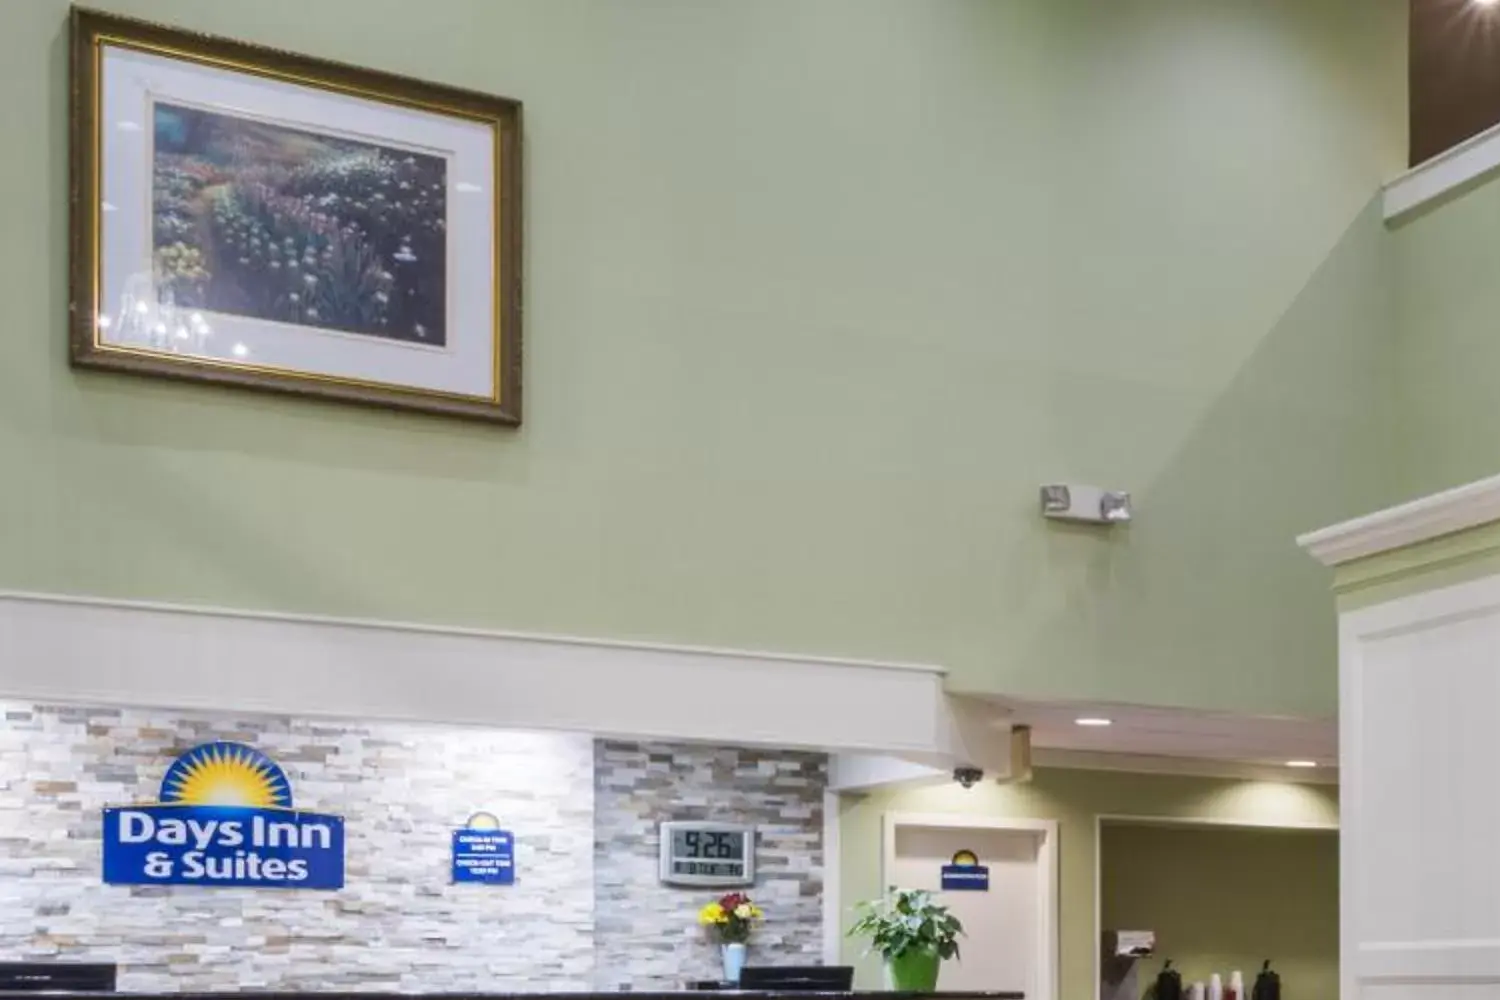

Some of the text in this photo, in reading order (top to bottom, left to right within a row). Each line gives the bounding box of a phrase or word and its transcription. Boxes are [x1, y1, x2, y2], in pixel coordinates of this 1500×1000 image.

[118, 811, 331, 849] Days Inn
[143, 850, 309, 880] & Suites
